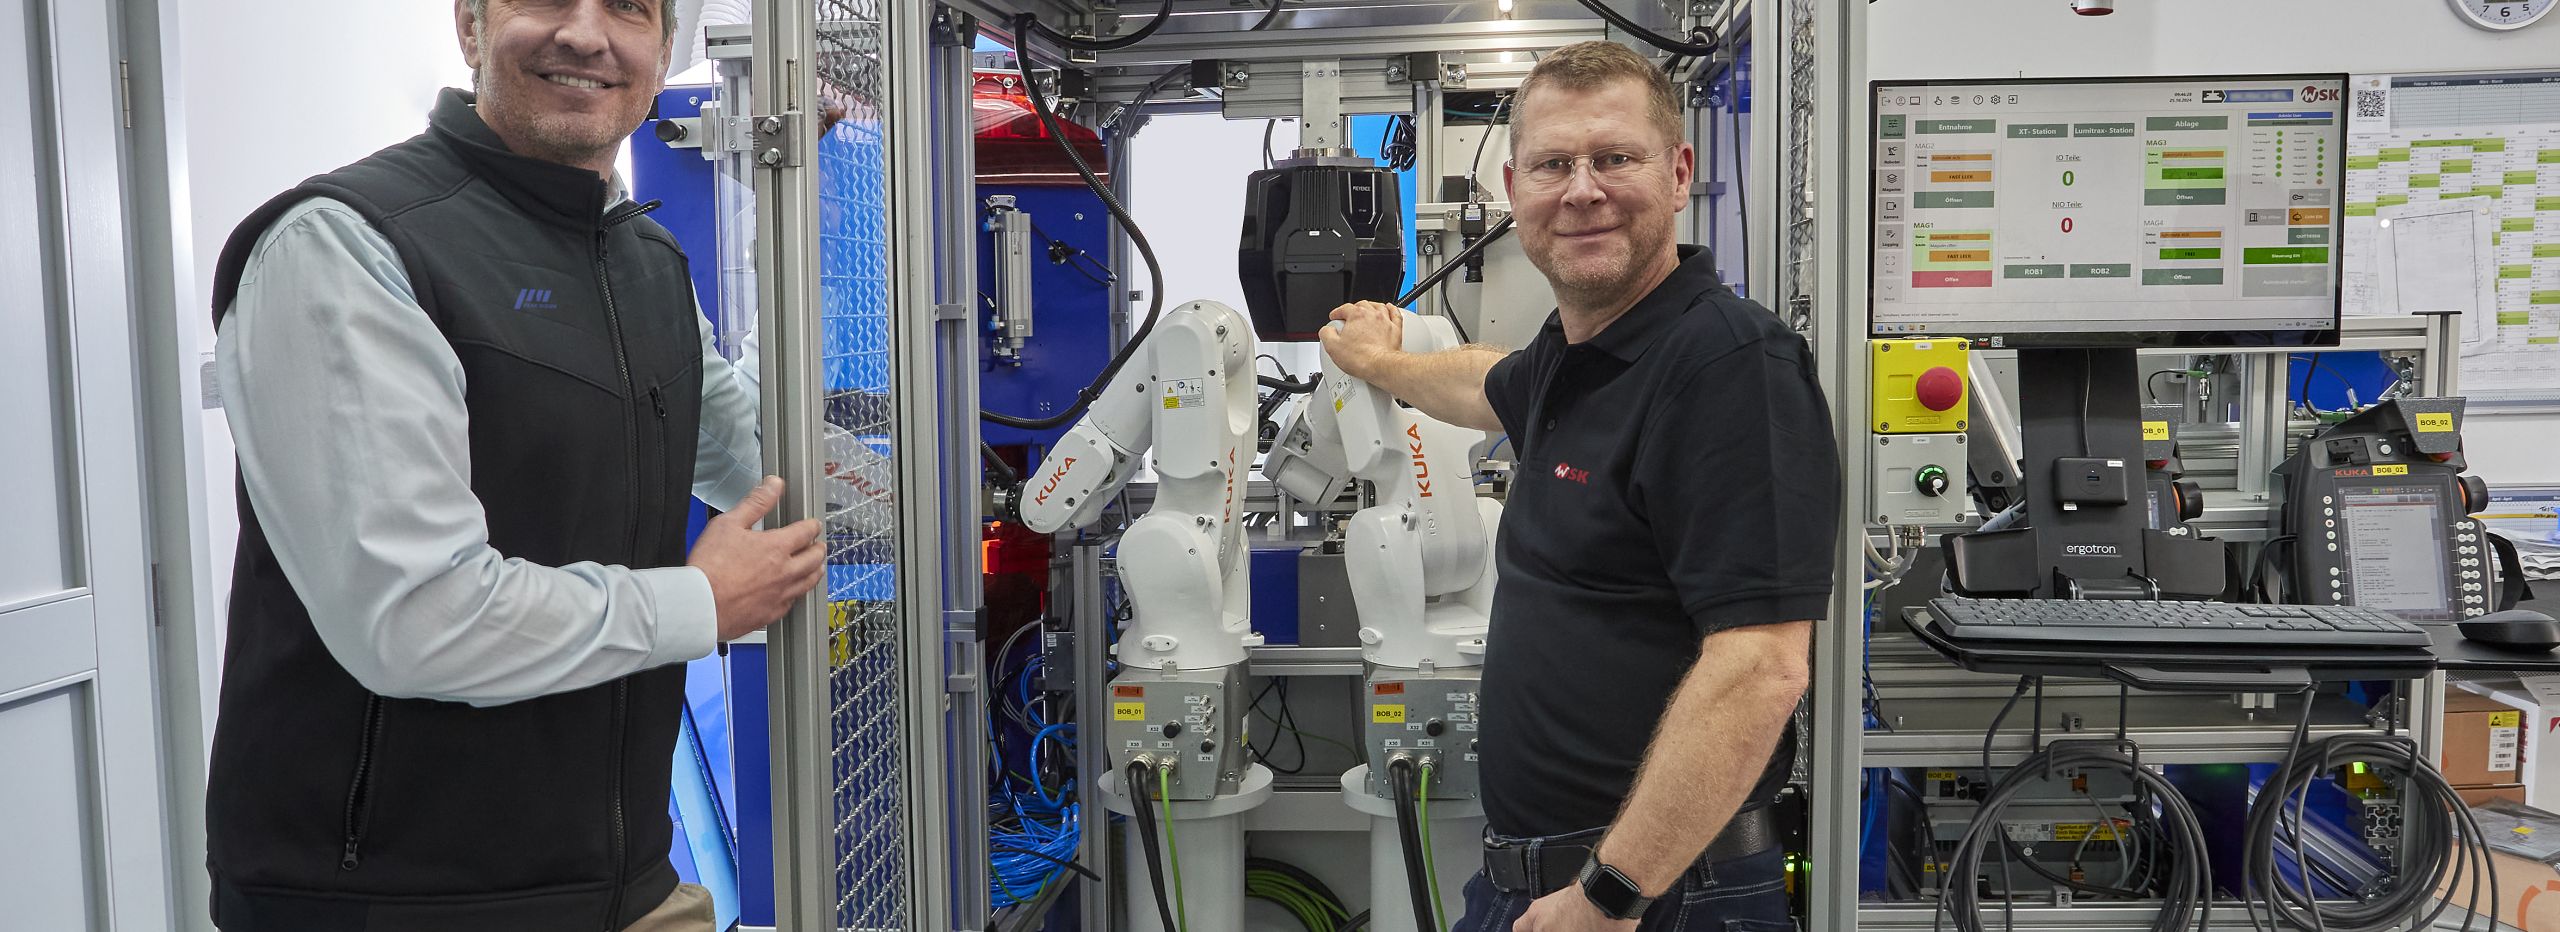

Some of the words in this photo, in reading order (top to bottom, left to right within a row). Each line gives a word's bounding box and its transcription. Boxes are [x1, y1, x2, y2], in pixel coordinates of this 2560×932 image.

[2500, 7, 2510, 17] 6
[2175, 120, 2200, 128] Ablage
[2062, 170, 2074, 186] 0
[2060, 217, 2073, 234] 0
[1407, 423, 1432, 498] KUKA
[1035, 457, 1077, 506] KUKA
[1224, 446, 1236, 524] KUKA
[2066, 544, 2116, 554] ergotron
